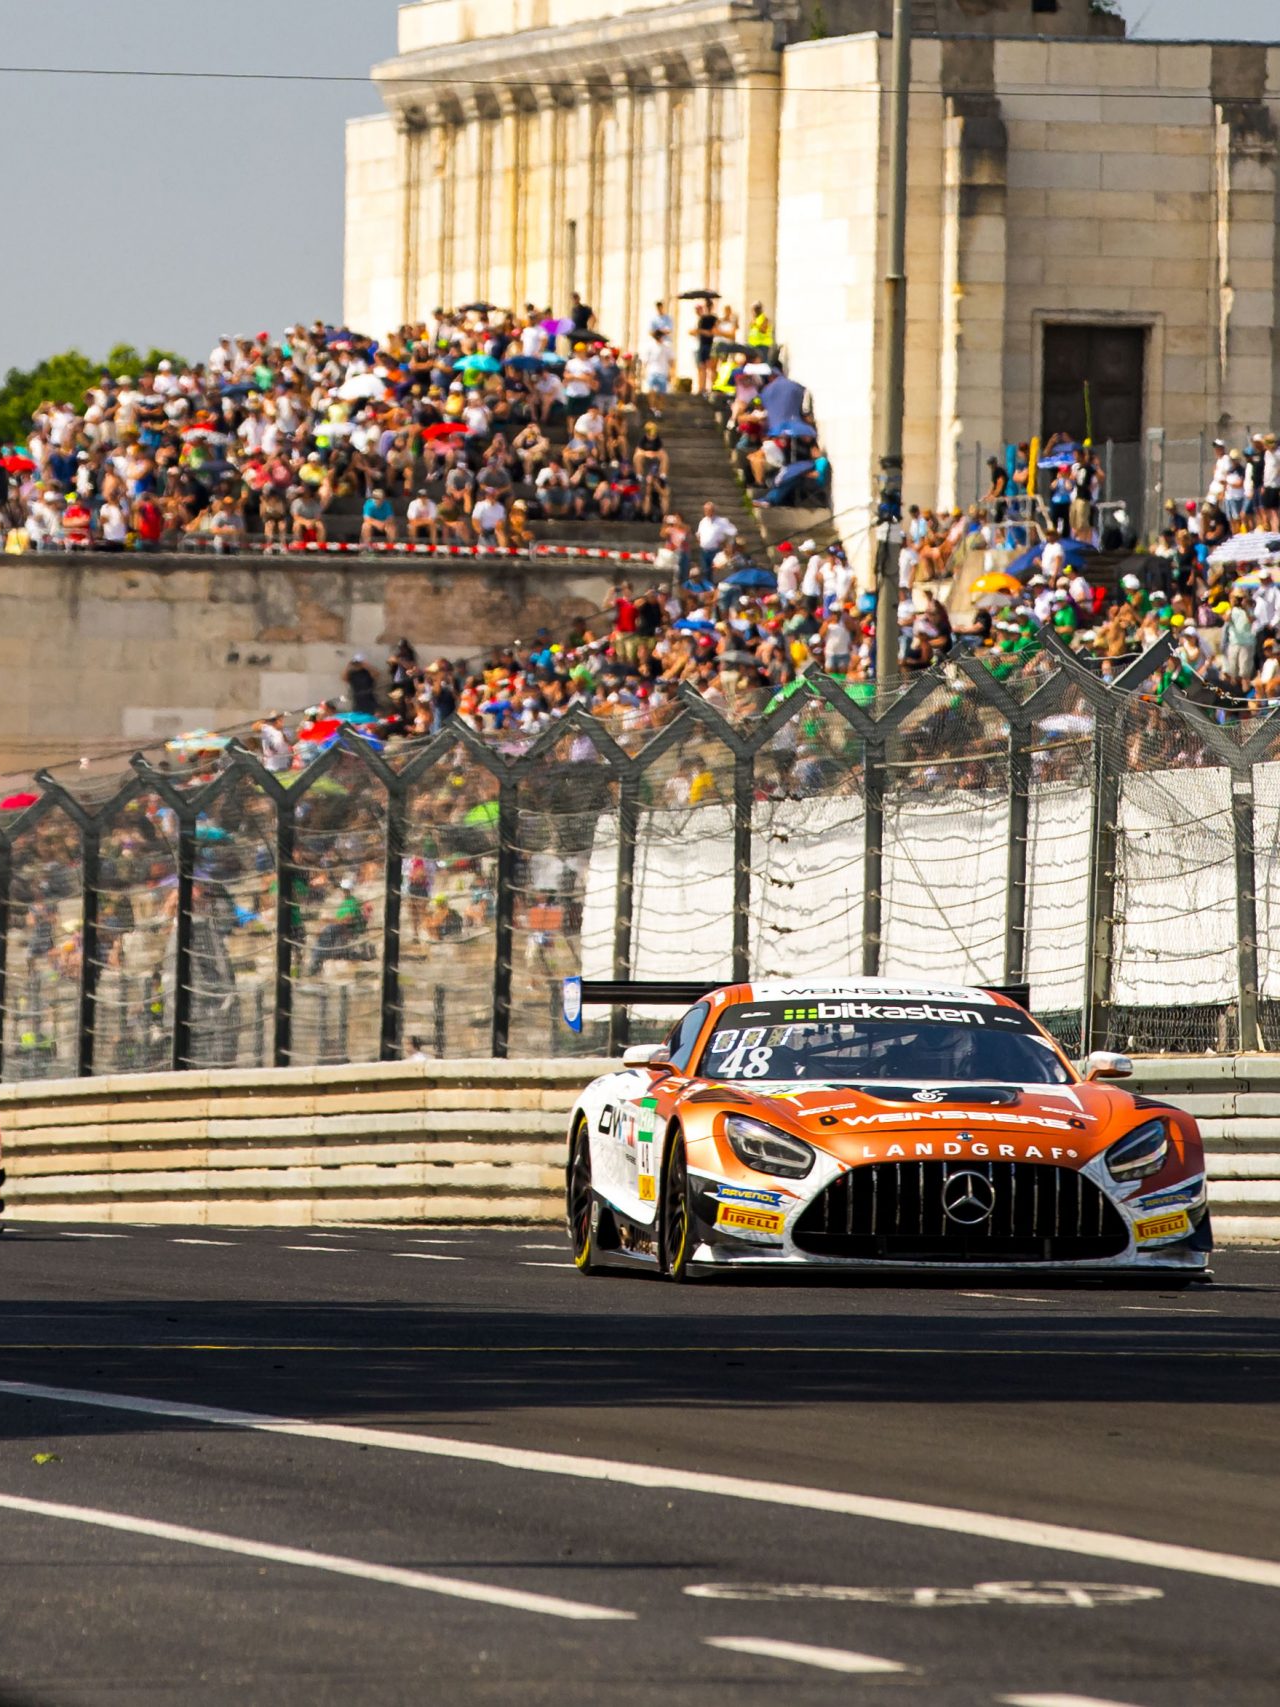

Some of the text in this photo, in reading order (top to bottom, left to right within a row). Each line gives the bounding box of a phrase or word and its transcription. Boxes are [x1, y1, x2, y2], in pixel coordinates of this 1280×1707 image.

[817, 1002, 986, 1025] bitkasten
[717, 1046, 773, 1079] 48
[842, 1109, 1072, 1131] WEINSBERG
[721, 1188, 777, 1204] RAVENOL
[722, 1207, 780, 1231] PIRELLI
[1136, 1214, 1184, 1238] PIRELLI
